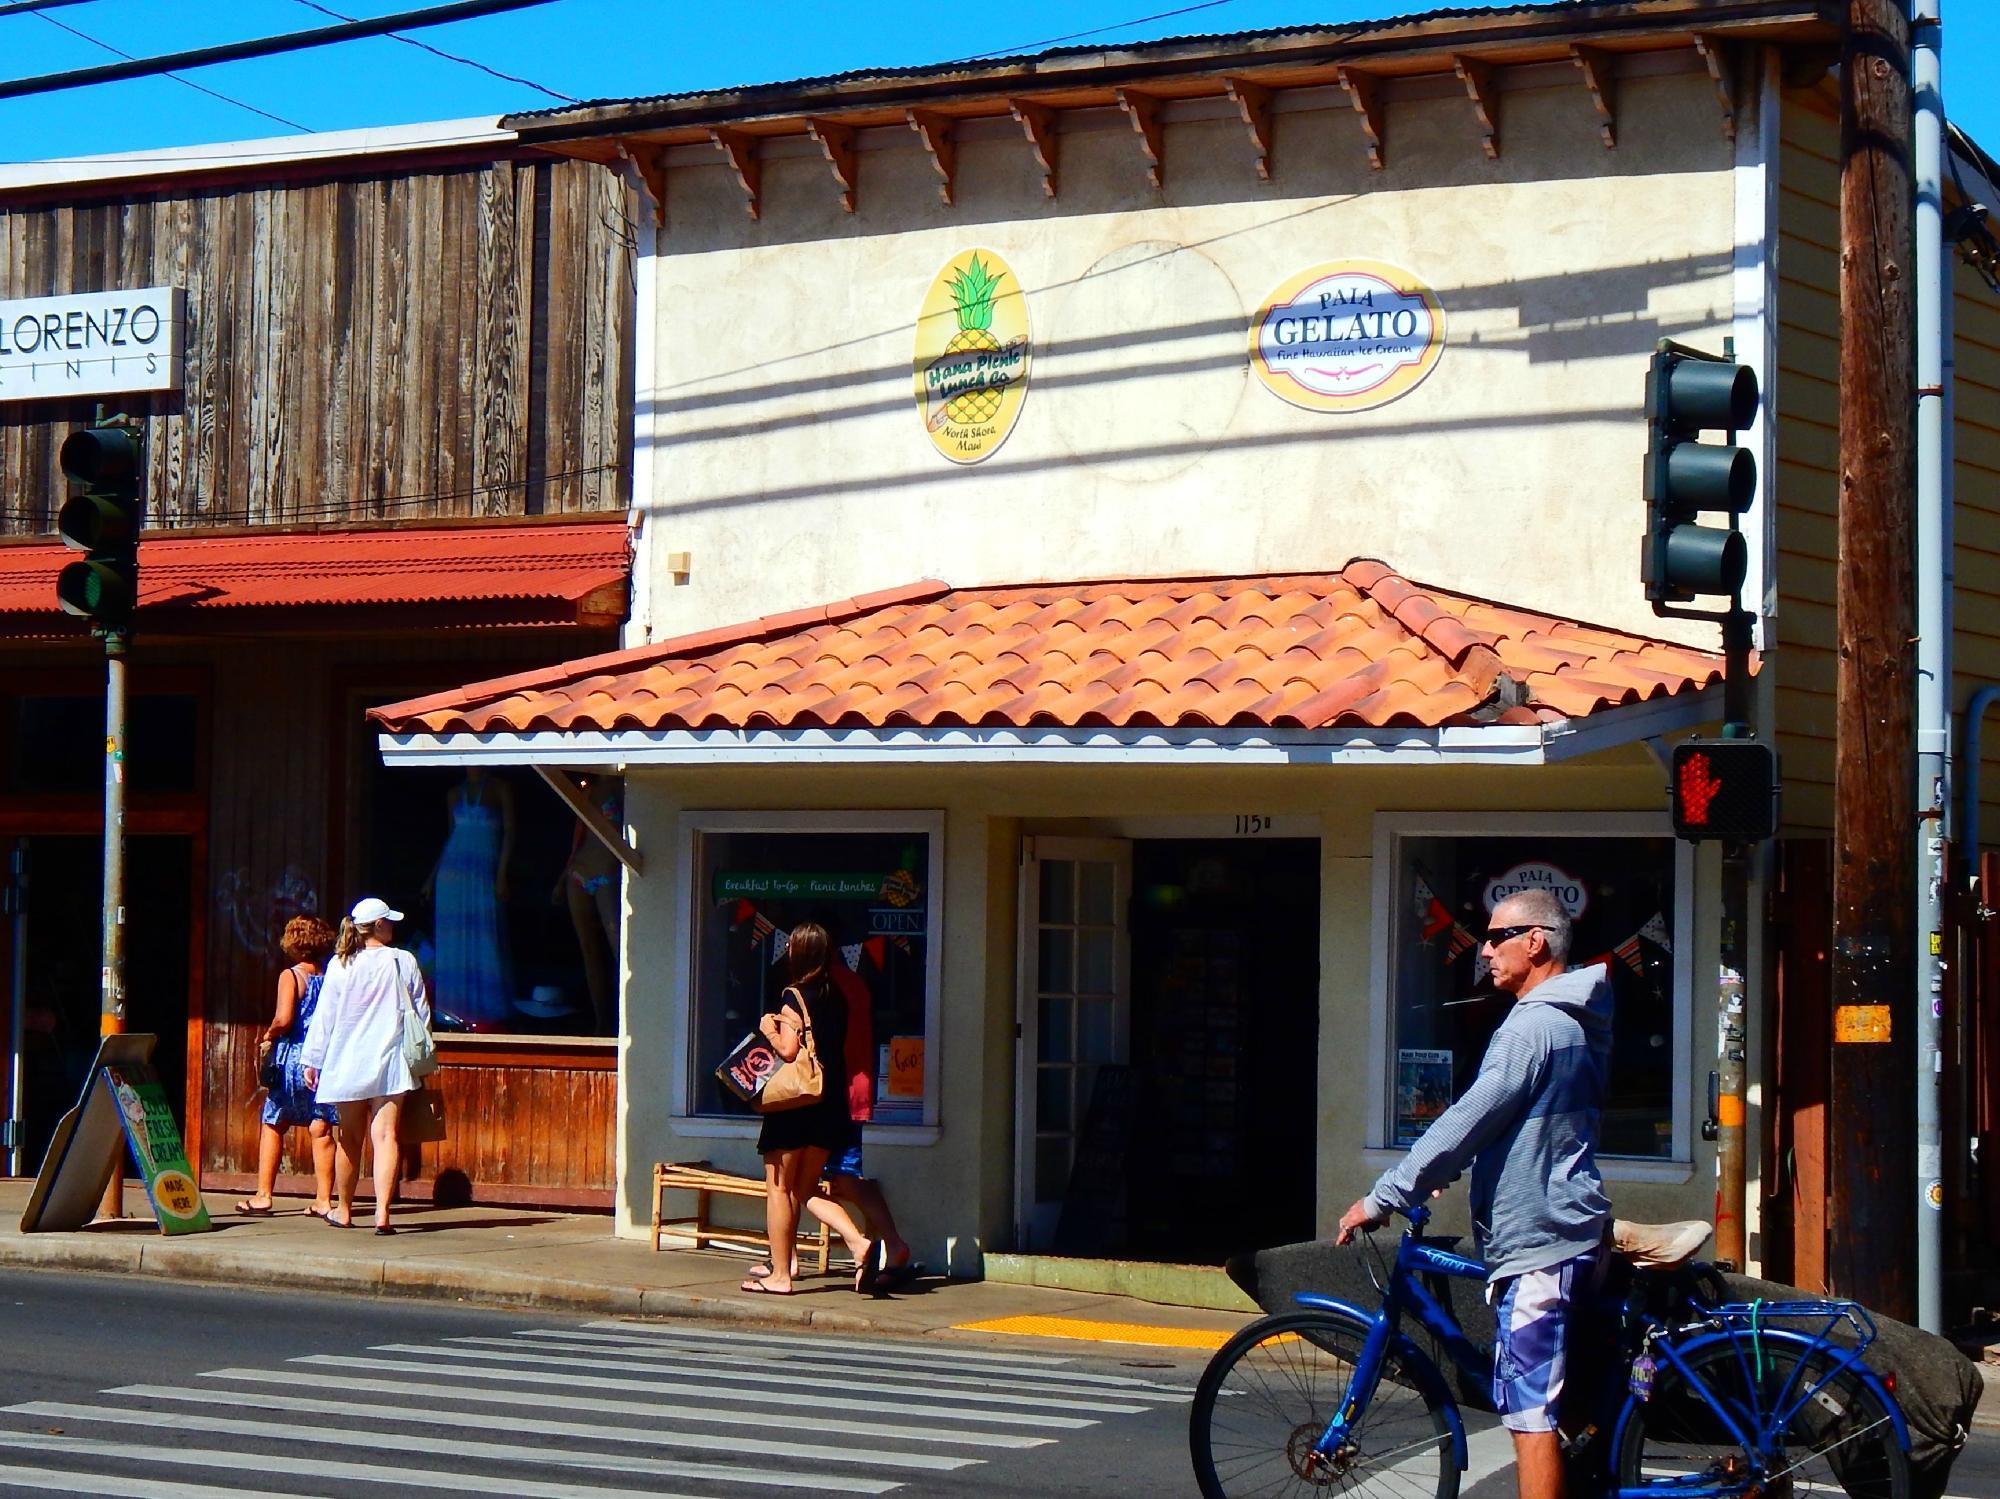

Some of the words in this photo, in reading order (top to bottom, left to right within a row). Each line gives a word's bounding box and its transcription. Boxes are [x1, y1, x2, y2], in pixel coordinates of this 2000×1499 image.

[1318, 288, 1373, 311] PAIA
[0, 305, 159, 354] LORENZO
[1274, 309, 1417, 345] GELATO
[1359, 345, 1372, 355] Ice
[1376, 343, 1412, 354] Cream
[0, 352, 157, 384] INIS
[929, 361, 972, 387] Hana
[976, 349, 1020, 372] Picnic
[940, 371, 984, 398] Lunch
[943, 425, 968, 438] North
[971, 425, 996, 438] Shore
[956, 439, 981, 451] Maui
[1519, 869, 1552, 883] PAIA
[725, 879, 769, 891] Breakfast
[809, 880, 836, 892] Picnic
[838, 880, 876, 892] Lunches
[872, 912, 920, 930] OPEN
[164, 1179, 185, 1193] MADE
[171, 1196, 192, 1210] HERE
